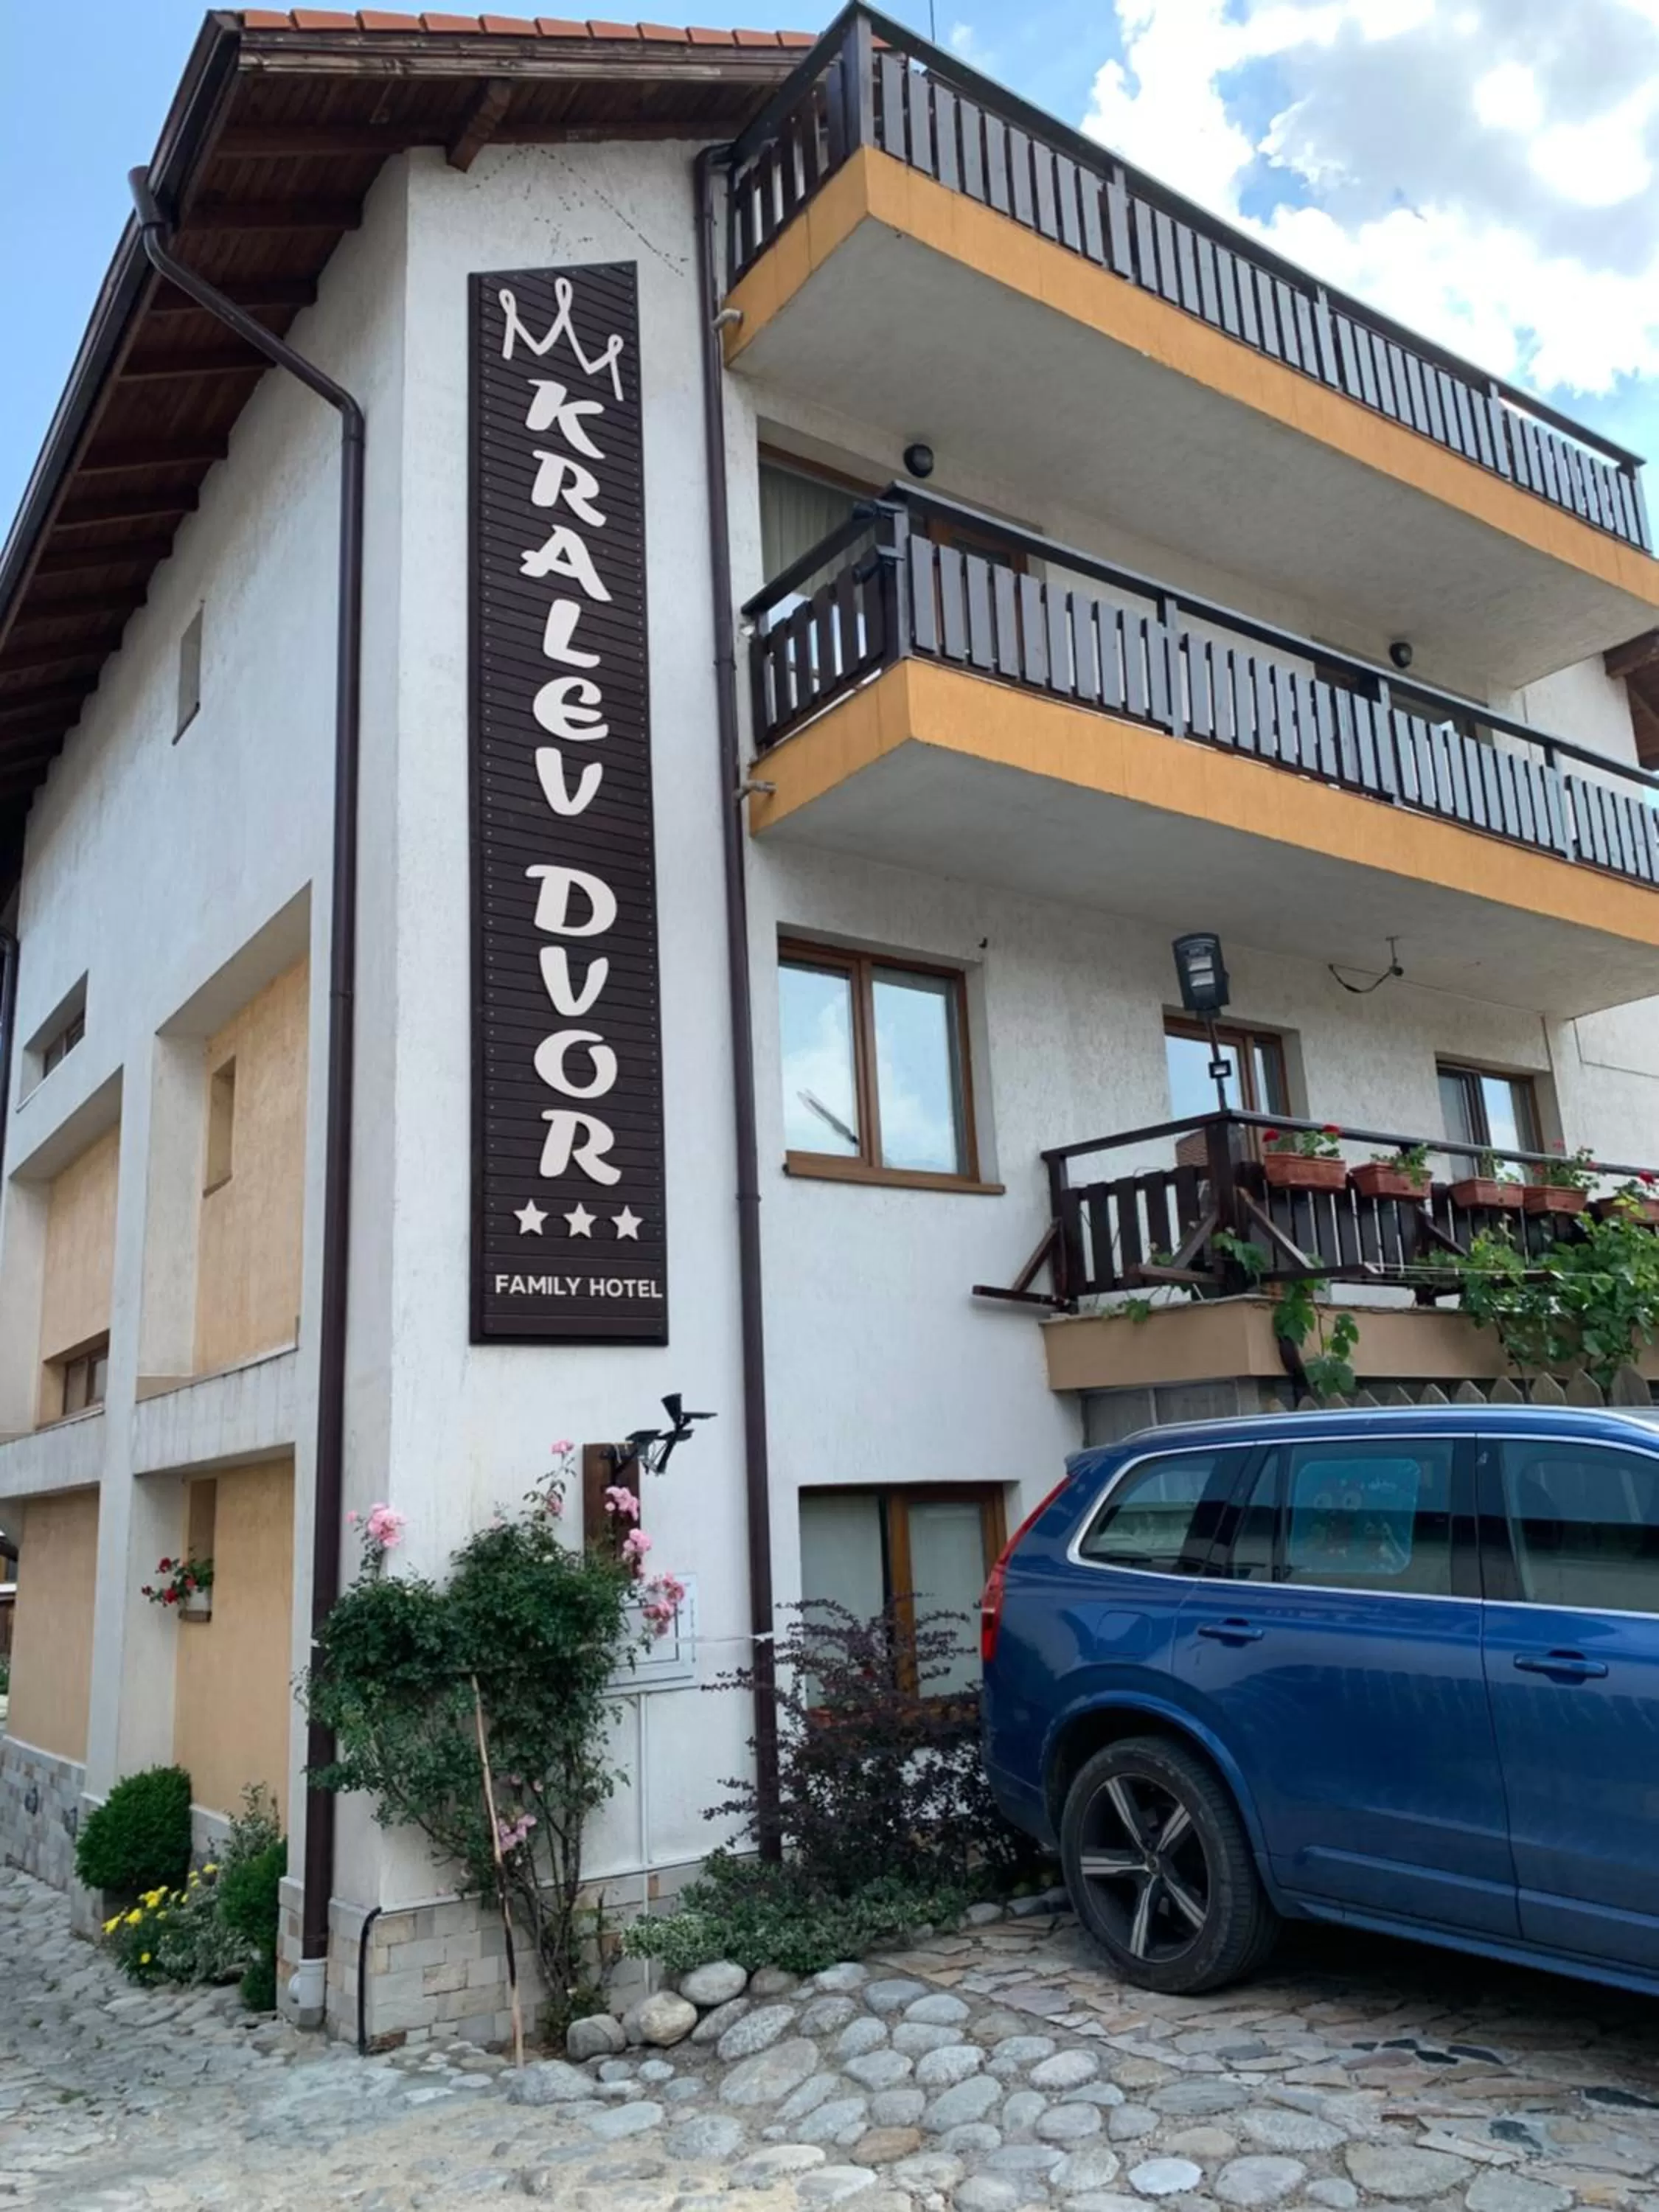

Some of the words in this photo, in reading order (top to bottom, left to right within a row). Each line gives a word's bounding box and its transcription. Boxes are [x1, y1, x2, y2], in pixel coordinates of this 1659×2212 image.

[520, 378, 612, 816] KRALEV
[526, 864, 622, 1186] DVOR
[495, 1274, 581, 1296] FAMILY
[589, 1277, 663, 1298] HOTEL
